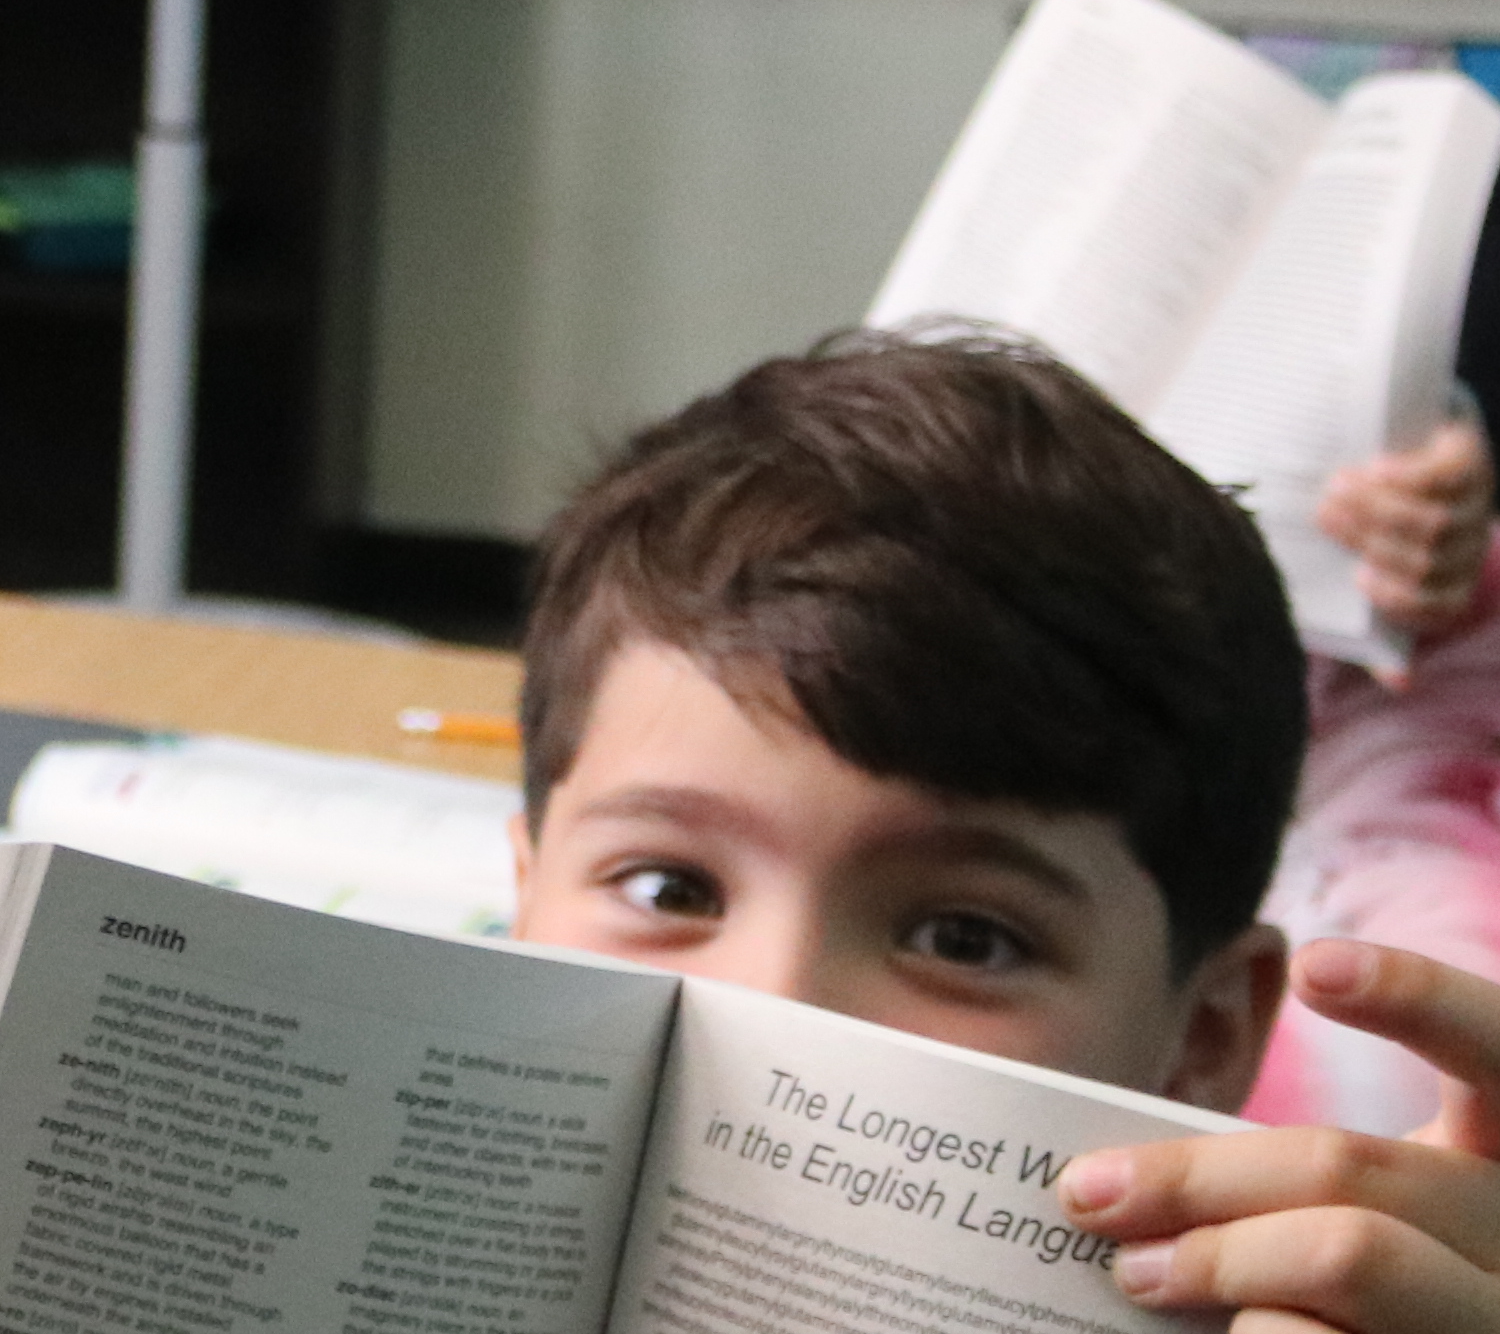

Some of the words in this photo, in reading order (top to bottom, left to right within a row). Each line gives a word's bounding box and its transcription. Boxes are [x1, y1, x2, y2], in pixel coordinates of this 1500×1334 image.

[99, 916, 187, 953] zenith
[703, 1110, 735, 1152] in
[738, 1124, 794, 1171] the
[800, 1142, 946, 1220] English
[764, 1068, 828, 1122] The
[836, 1092, 1006, 1175] Longest
[1017, 1144, 1072, 1191] W
